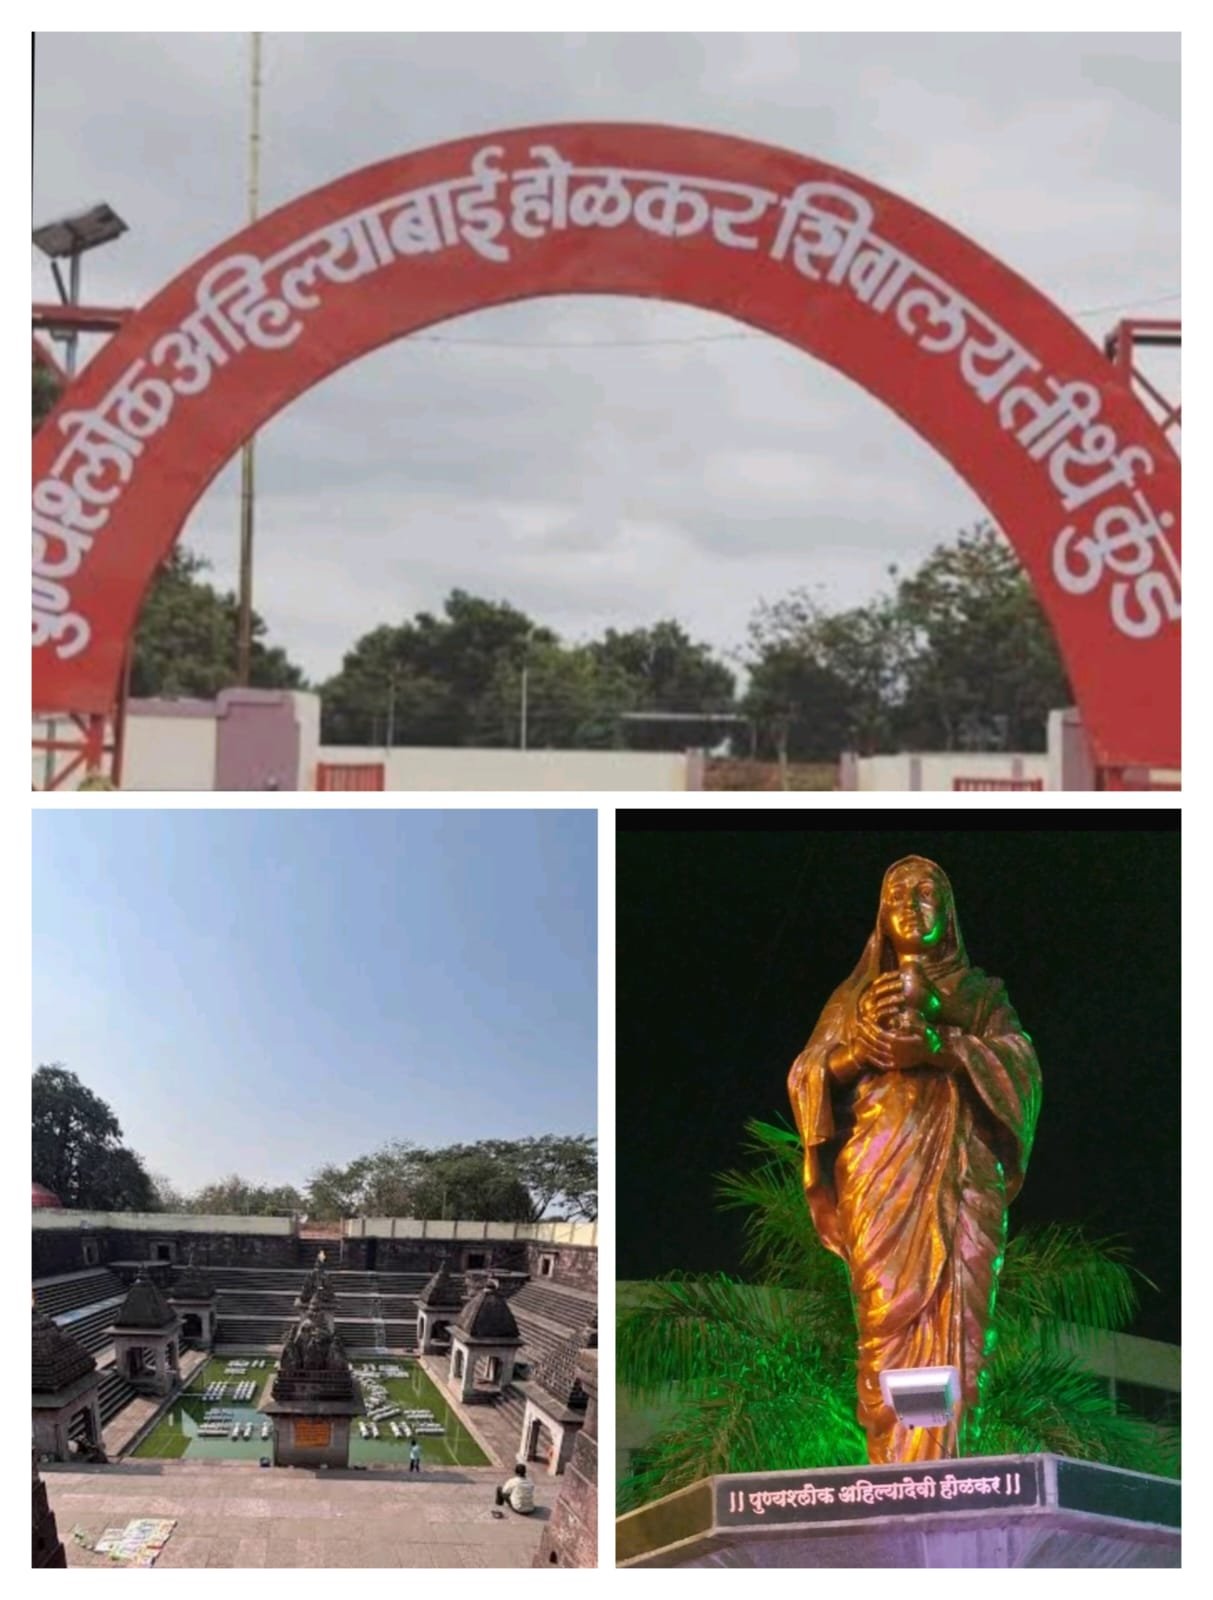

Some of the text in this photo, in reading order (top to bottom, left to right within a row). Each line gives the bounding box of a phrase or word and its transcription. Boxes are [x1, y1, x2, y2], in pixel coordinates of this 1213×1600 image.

[152, 145, 510, 396] अहिल्याबाई
[511, 145, 776, 249] होळकर
[770, 181, 1041, 404] शिवालय
[999, 376, 1155, 512] तीर्थ
[748, 1483, 835, 1515] पुण्यश्लोक
[838, 1475, 937, 1504] अहिल्यादेवी
[939, 1473, 1001, 1500] होळकर
